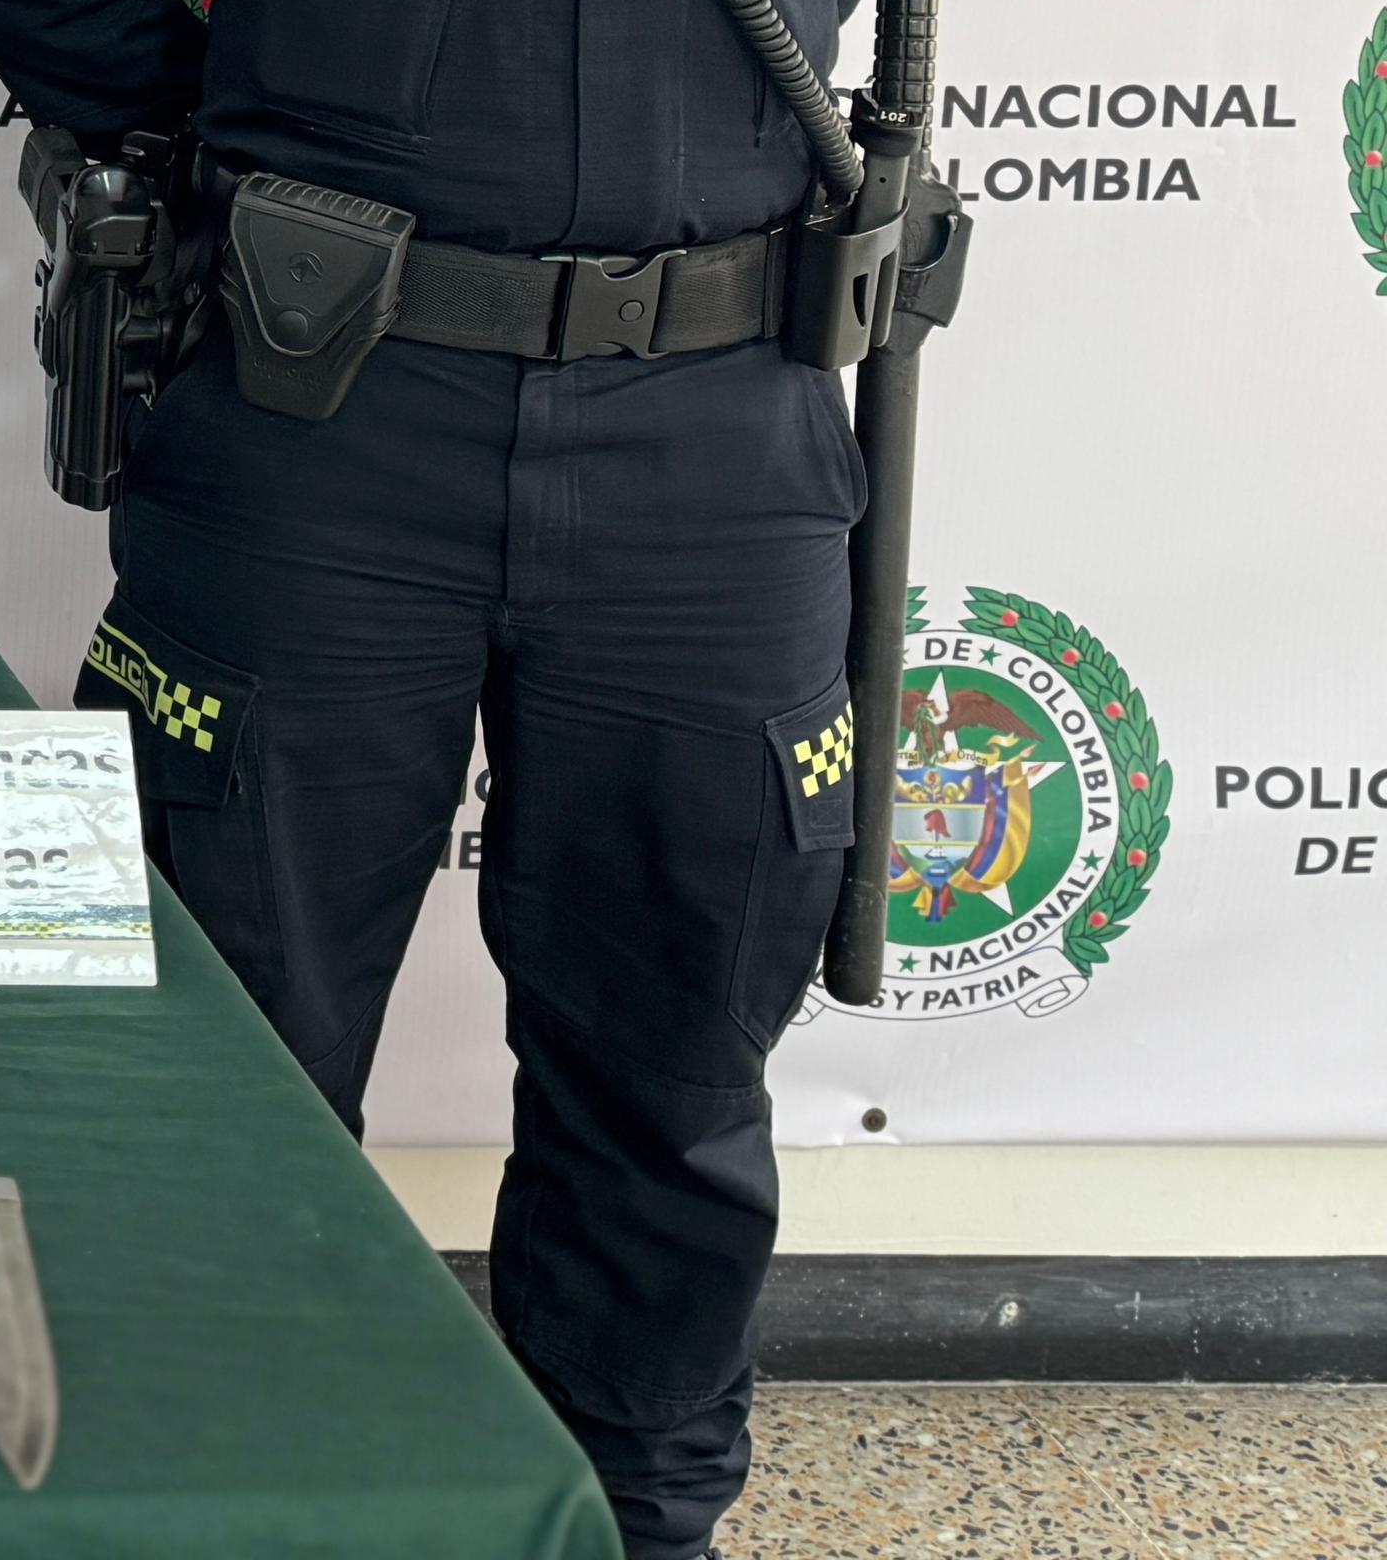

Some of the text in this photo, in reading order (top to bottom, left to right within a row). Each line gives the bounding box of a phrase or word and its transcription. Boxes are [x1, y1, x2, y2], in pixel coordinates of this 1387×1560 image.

[940, 83, 1297, 129] NACIONAL
[934, 157, 1201, 202] LOMBIA
[923, 637, 1113, 834] DE COLOMBIA
[1293, 835, 1379, 876] DE
[928, 867, 1095, 974] NACIONAL
[891, 989, 915, 1012] Y
[920, 963, 1043, 1012] PATRIA
